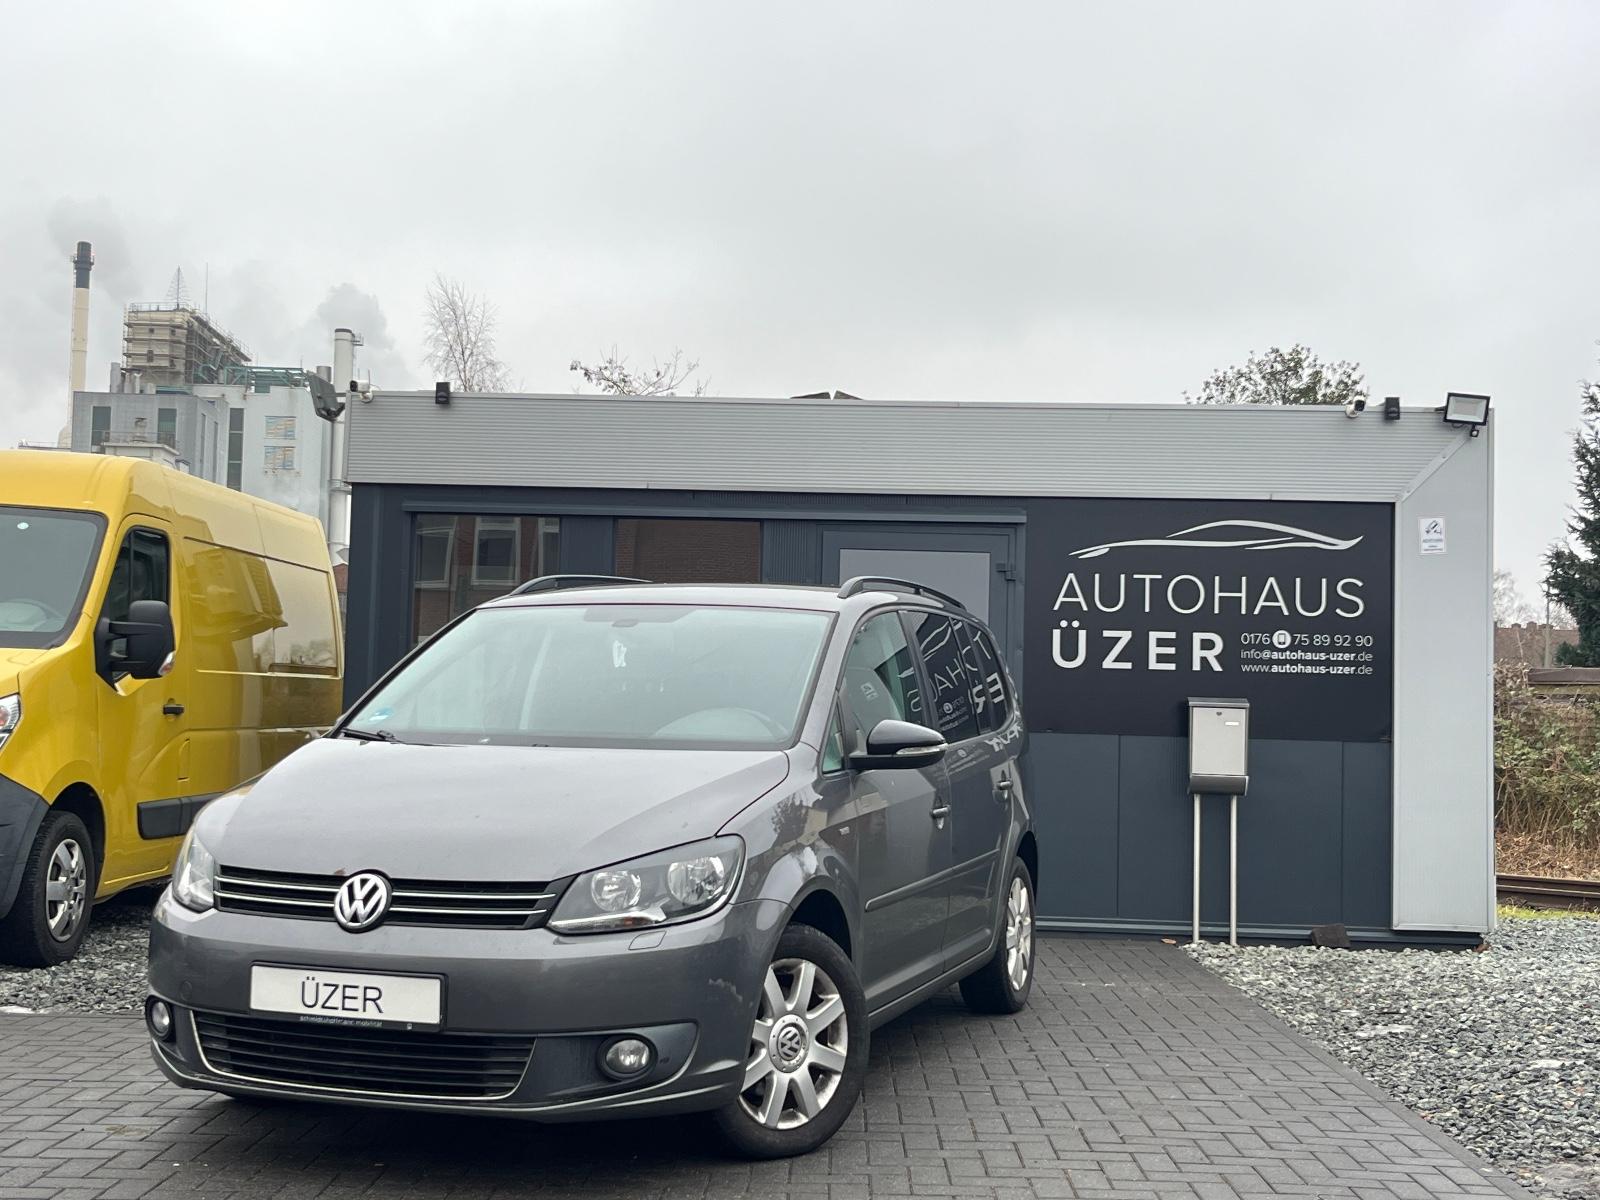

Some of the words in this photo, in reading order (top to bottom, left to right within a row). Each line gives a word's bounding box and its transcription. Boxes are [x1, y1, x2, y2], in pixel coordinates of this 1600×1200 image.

[1053, 573, 1365, 618] AUTOHAUS
[1052, 619, 1224, 672] ÜZER
[1240, 632, 1271, 645] 0176
[1293, 633, 1310, 646] 75
[1312, 634, 1331, 646] 89
[1333, 634, 1352, 647] 92
[1355, 635, 1374, 647] 90
[1240, 649, 1374, 662] info@autohaus-uzer.de
[1240, 663, 1374, 675] www.autohaus-uzer.de
[334, 872, 390, 927] VW
[301, 976, 384, 1014] ÜZER
